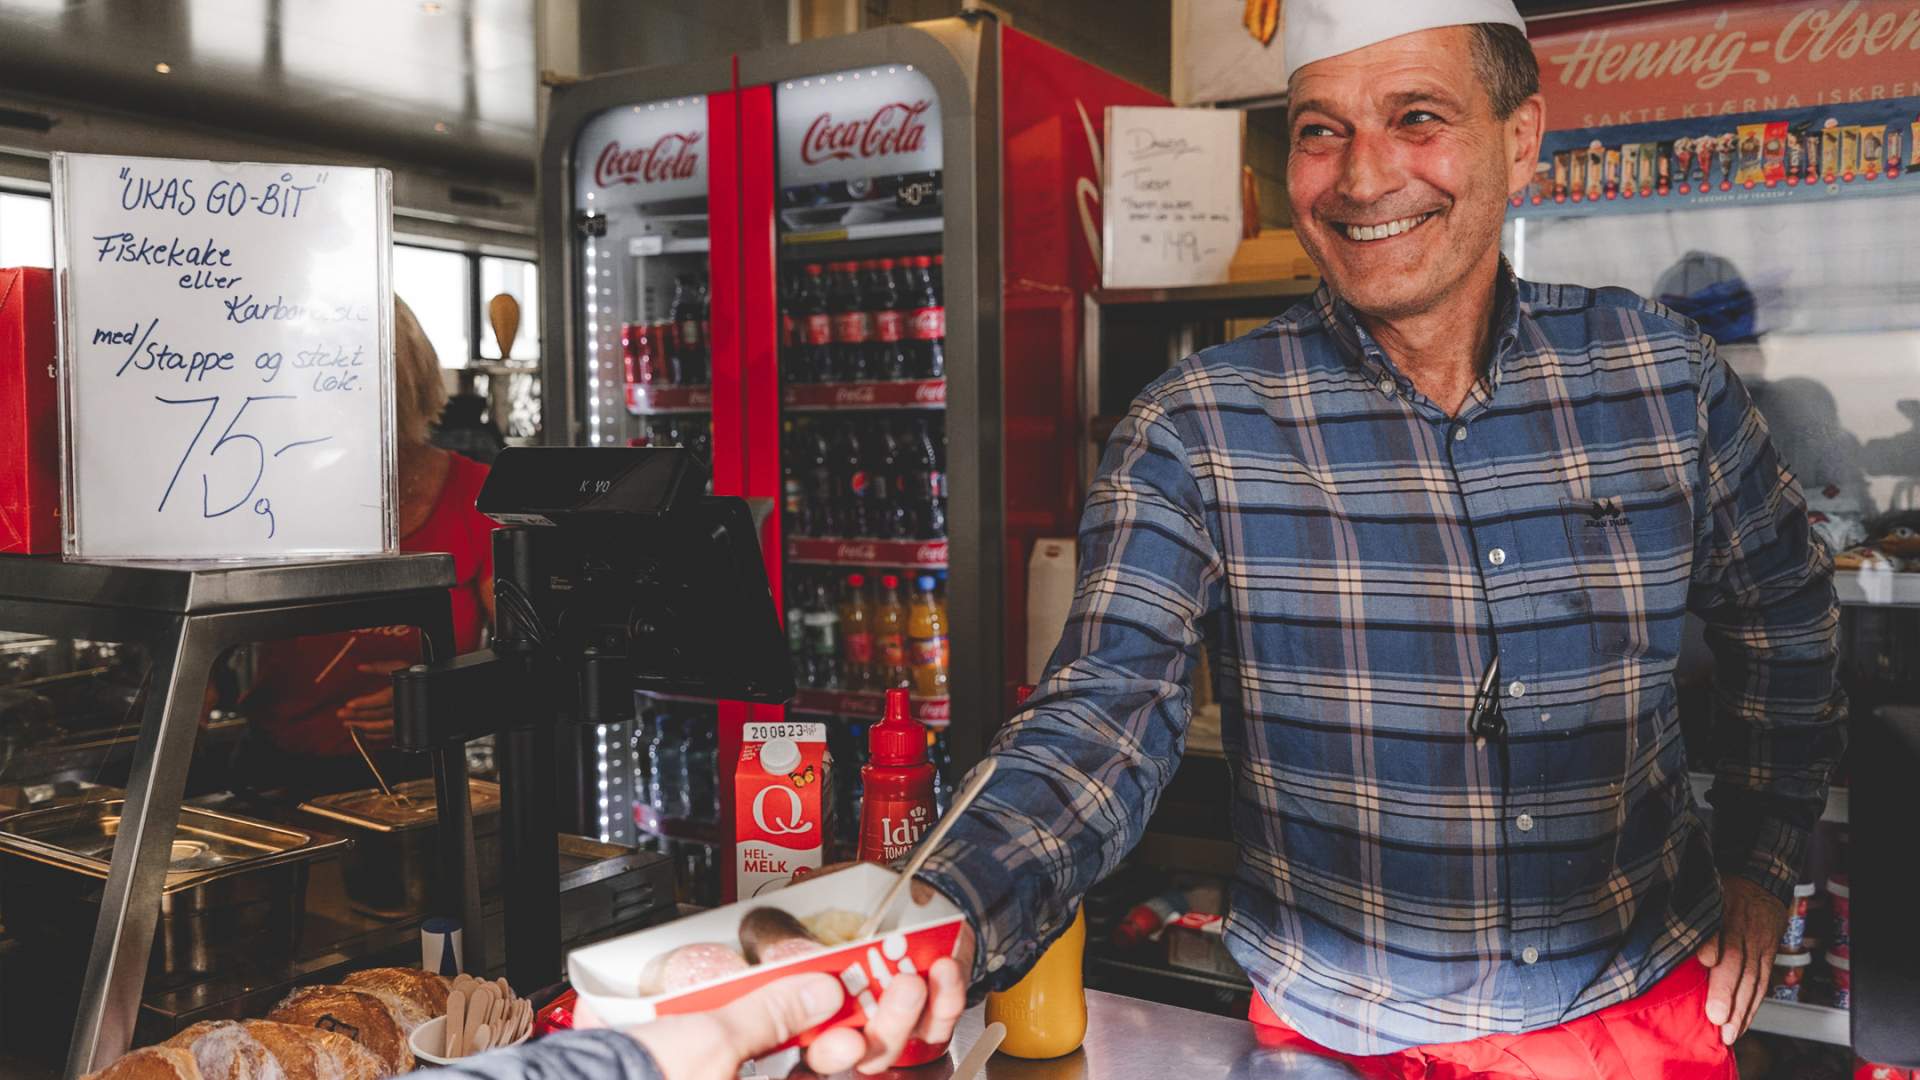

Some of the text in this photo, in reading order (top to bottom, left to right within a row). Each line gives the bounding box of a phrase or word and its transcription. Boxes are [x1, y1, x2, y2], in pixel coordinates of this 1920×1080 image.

[1583, 107, 1667, 129] SAKTE
[1683, 93, 1800, 119] KJÆRNA
[800, 100, 931, 166] Coca-Cola
[594, 132, 703, 189] Coca-Cola
[93, 233, 233, 267] Fiskekake
[178, 271, 243, 290] eller
[255, 351, 281, 382] og
[753, 785, 813, 835] Q
[881, 817, 933, 846] Idu
[744, 849, 774, 860] HEL-
[744, 861, 788, 873] MELK
